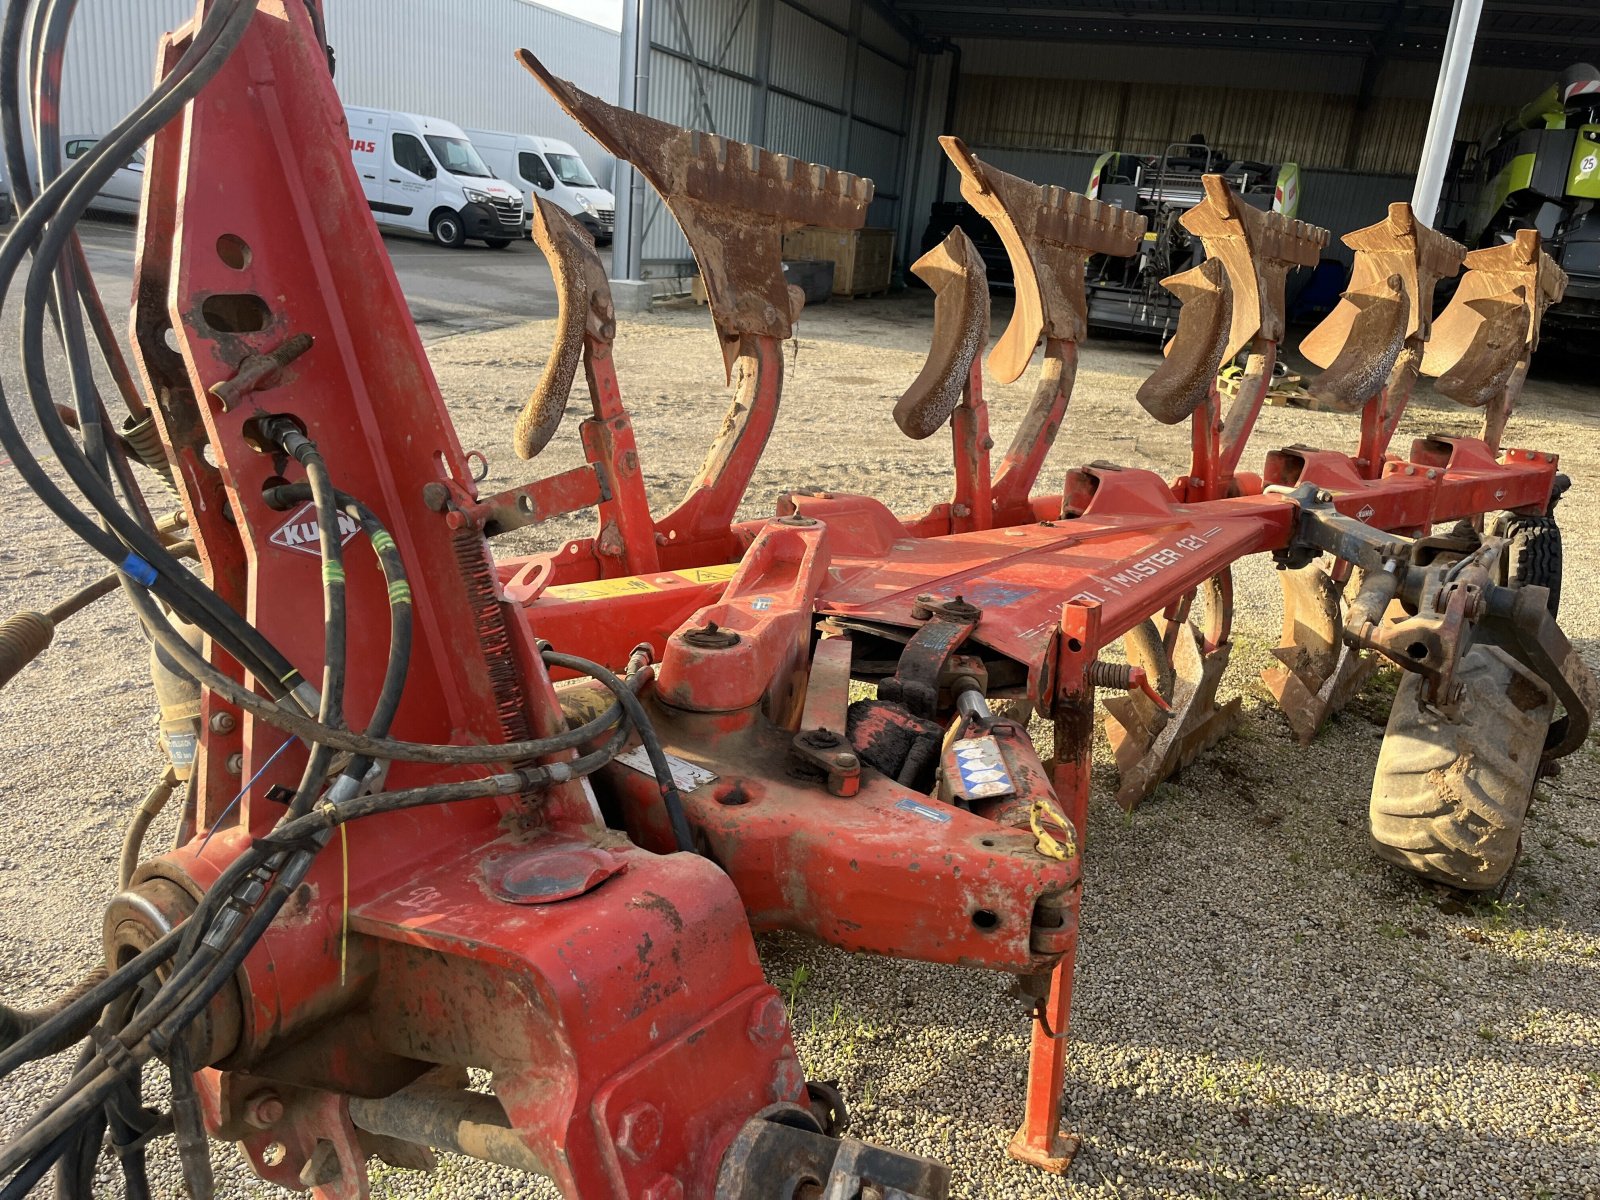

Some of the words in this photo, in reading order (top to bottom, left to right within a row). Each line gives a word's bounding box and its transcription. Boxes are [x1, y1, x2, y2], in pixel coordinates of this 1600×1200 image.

[1582, 157, 1595, 170] 25
[282, 515, 357, 546] KUN
[1110, 548, 1184, 588] MASTER
[1176, 534, 1208, 552] 121
